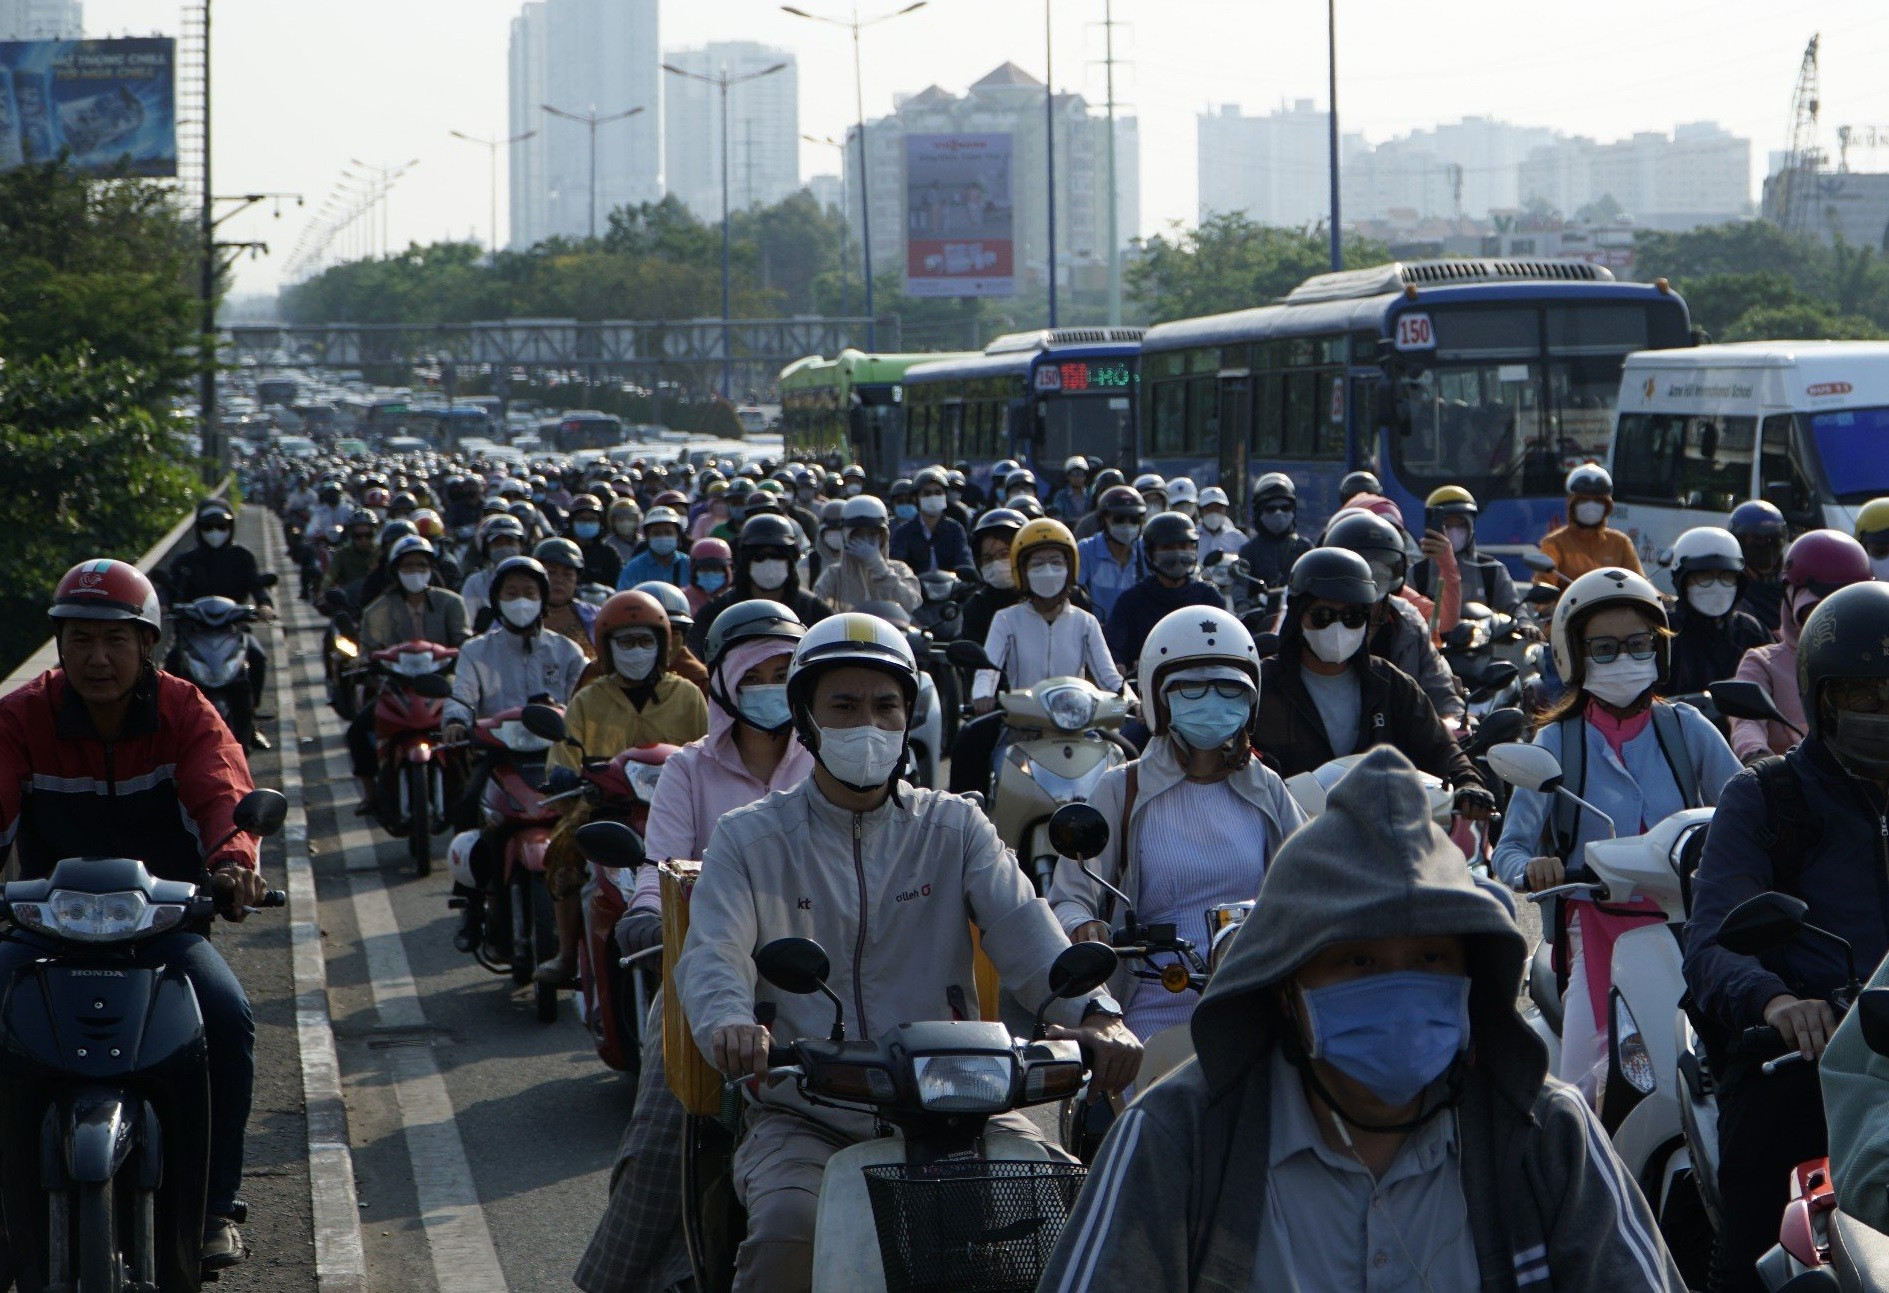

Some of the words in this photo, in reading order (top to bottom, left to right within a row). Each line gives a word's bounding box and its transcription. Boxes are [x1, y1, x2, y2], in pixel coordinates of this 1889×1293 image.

[1401, 319, 1430, 344] 150
[896, 889, 919, 902] olleh
[797, 898, 811, 910] kt
[71, 970, 125, 978] HONDA
